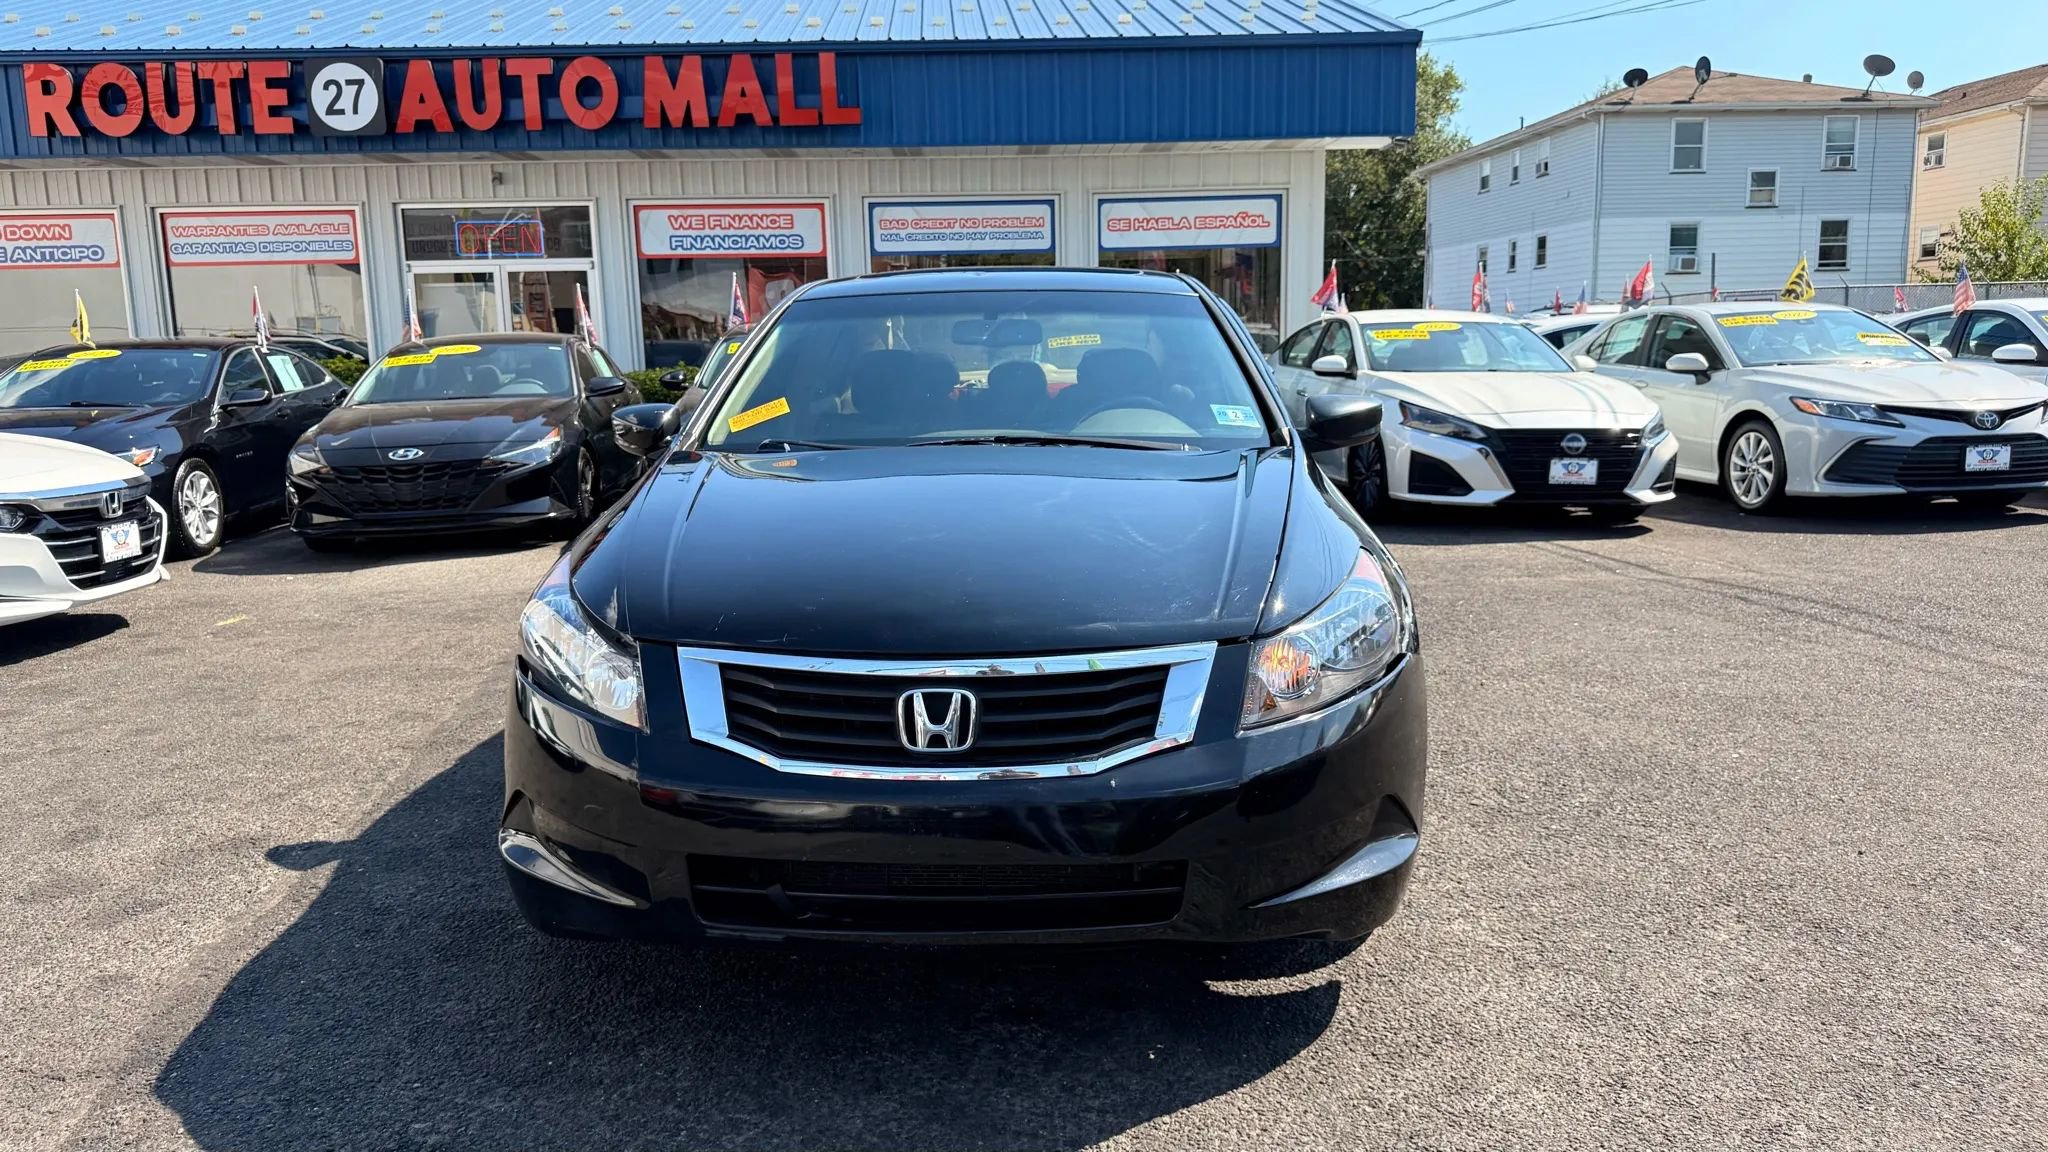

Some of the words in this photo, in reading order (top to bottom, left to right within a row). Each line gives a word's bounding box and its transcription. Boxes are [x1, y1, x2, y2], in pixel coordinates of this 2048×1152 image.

[22, 60, 295, 138] ROUTE
[321, 78, 367, 117] 27
[394, 56, 620, 134] AUTO
[643, 52, 862, 128] MALL
[172, 224, 270, 237] WARRANTIES
[272, 223, 350, 236] AVAILABLE
[668, 215, 705, 230] WE
[708, 214, 794, 229] FINANCE
[880, 219, 908, 230] BAD
[911, 218, 957, 230] CREDIT
[959, 218, 980, 229] NO
[982, 216, 1045, 228] PROBLEM
[1108, 218, 1131, 232] SE
[1133, 216, 1191, 231] HABLA
[1194, 212, 1270, 229] ESPAÑOL
[4, 224, 72, 240] DOWN
[459, 224, 540, 253] OPEN
[881, 232, 904, 242] MAL
[905, 232, 947, 241] CREDITO
[949, 232, 965, 241] NO
[966, 231, 989, 240] HAY
[990, 231, 1044, 240] PROBLEMA
[171, 242, 256, 255] GARANTIAS
[258, 240, 353, 253] DISPONIBLES
[670, 234, 804, 250] FINANCIAMOS
[11, 245, 103, 262] ANTICIPO
